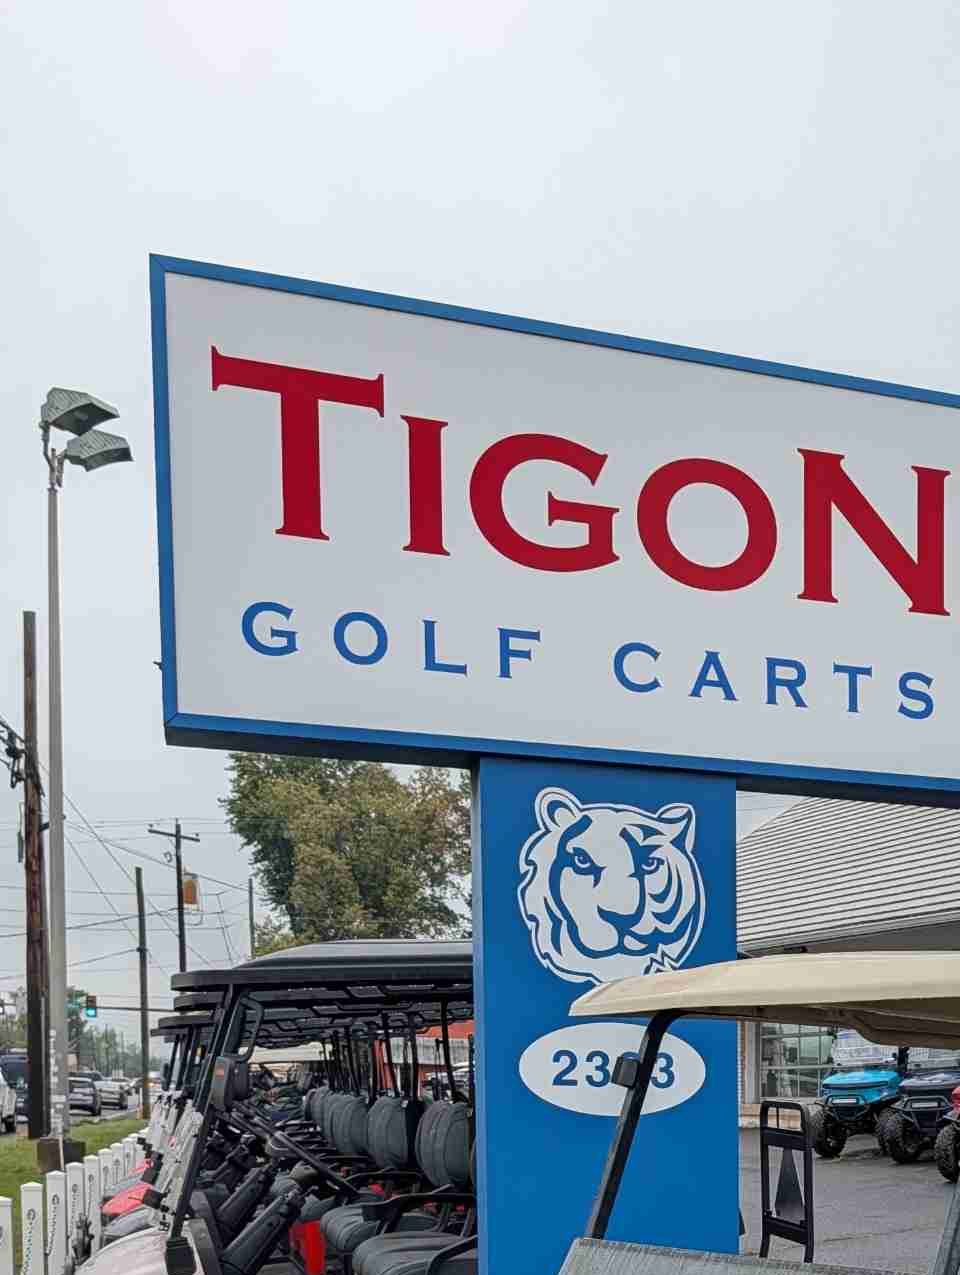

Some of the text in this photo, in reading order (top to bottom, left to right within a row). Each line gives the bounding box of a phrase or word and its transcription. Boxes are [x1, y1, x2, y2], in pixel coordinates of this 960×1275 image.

[211, 345, 951, 615] TIGON
[240, 600, 936, 721] GOLF CARTS
[551, 1049, 675, 1089] 233
